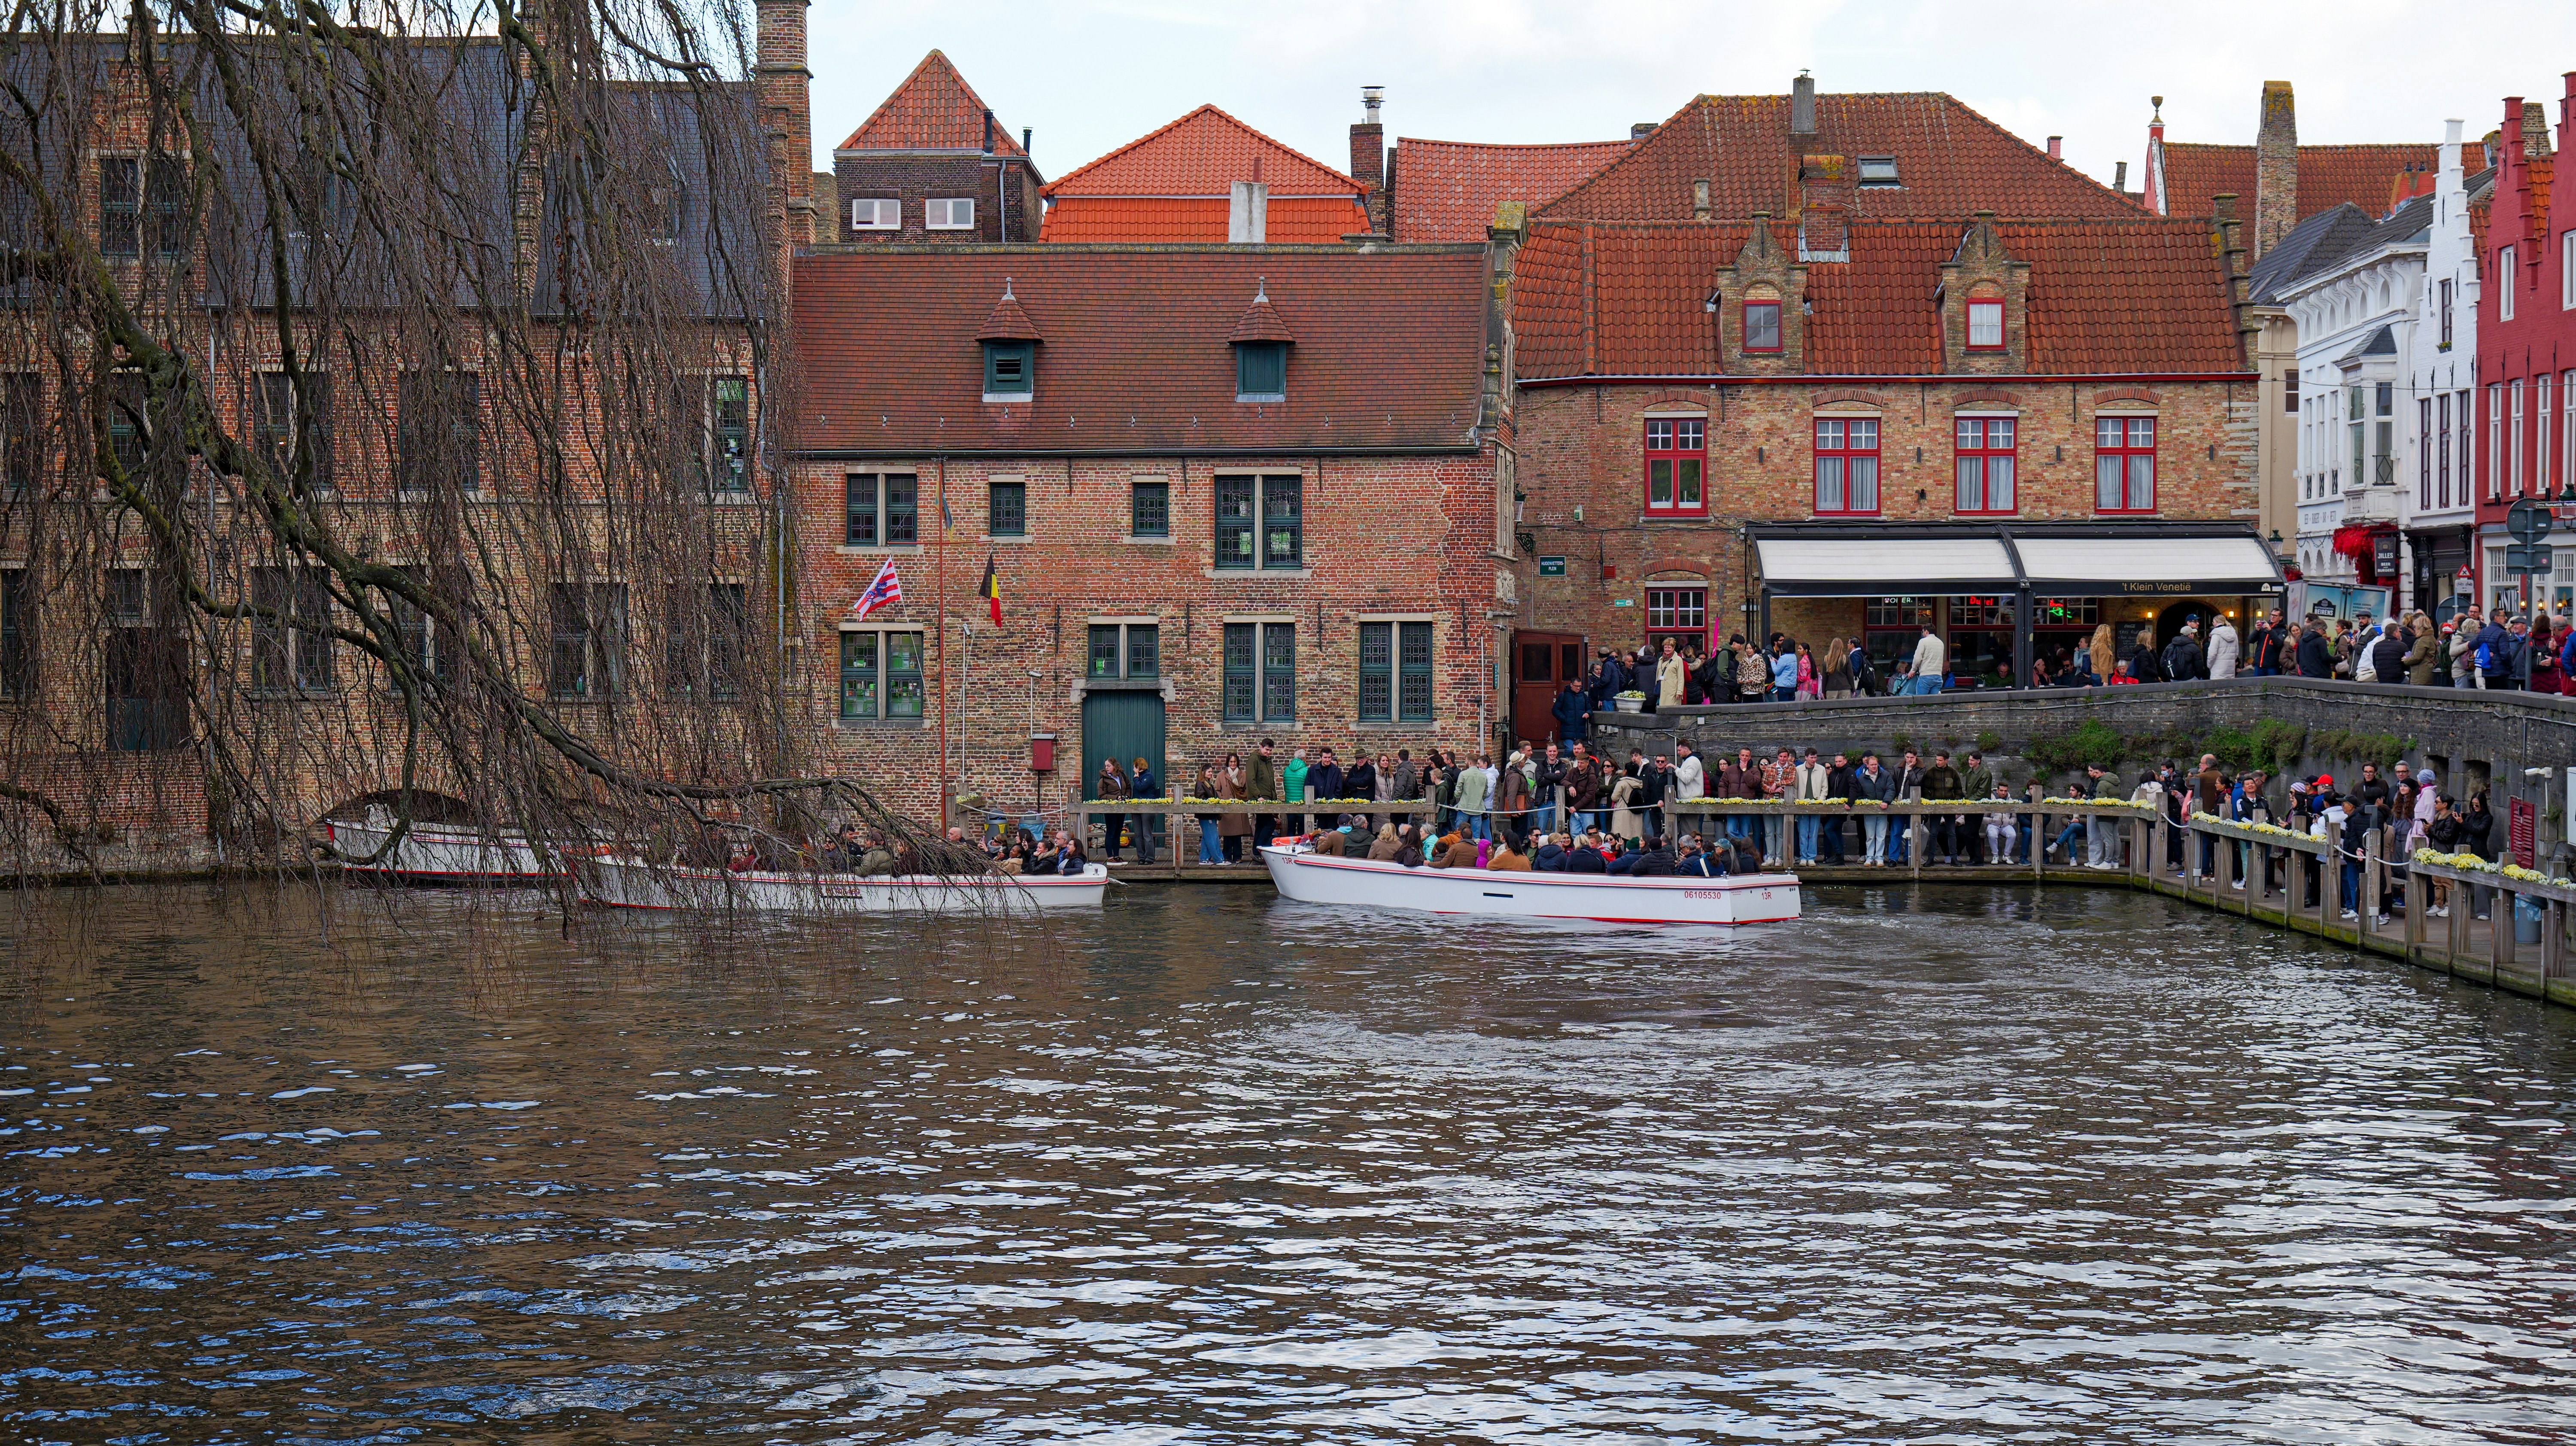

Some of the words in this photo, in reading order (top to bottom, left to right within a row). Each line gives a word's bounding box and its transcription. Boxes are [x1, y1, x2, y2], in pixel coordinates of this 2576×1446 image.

[2122, 583, 2127, 591] 't
[2130, 583, 2153, 591] Klein
[2156, 582, 2191, 591] Venetië
[1970, 595, 1993, 605] Duel
[1684, 891, 1721, 899] 06105530
[1762, 892, 1772, 900] 13R
